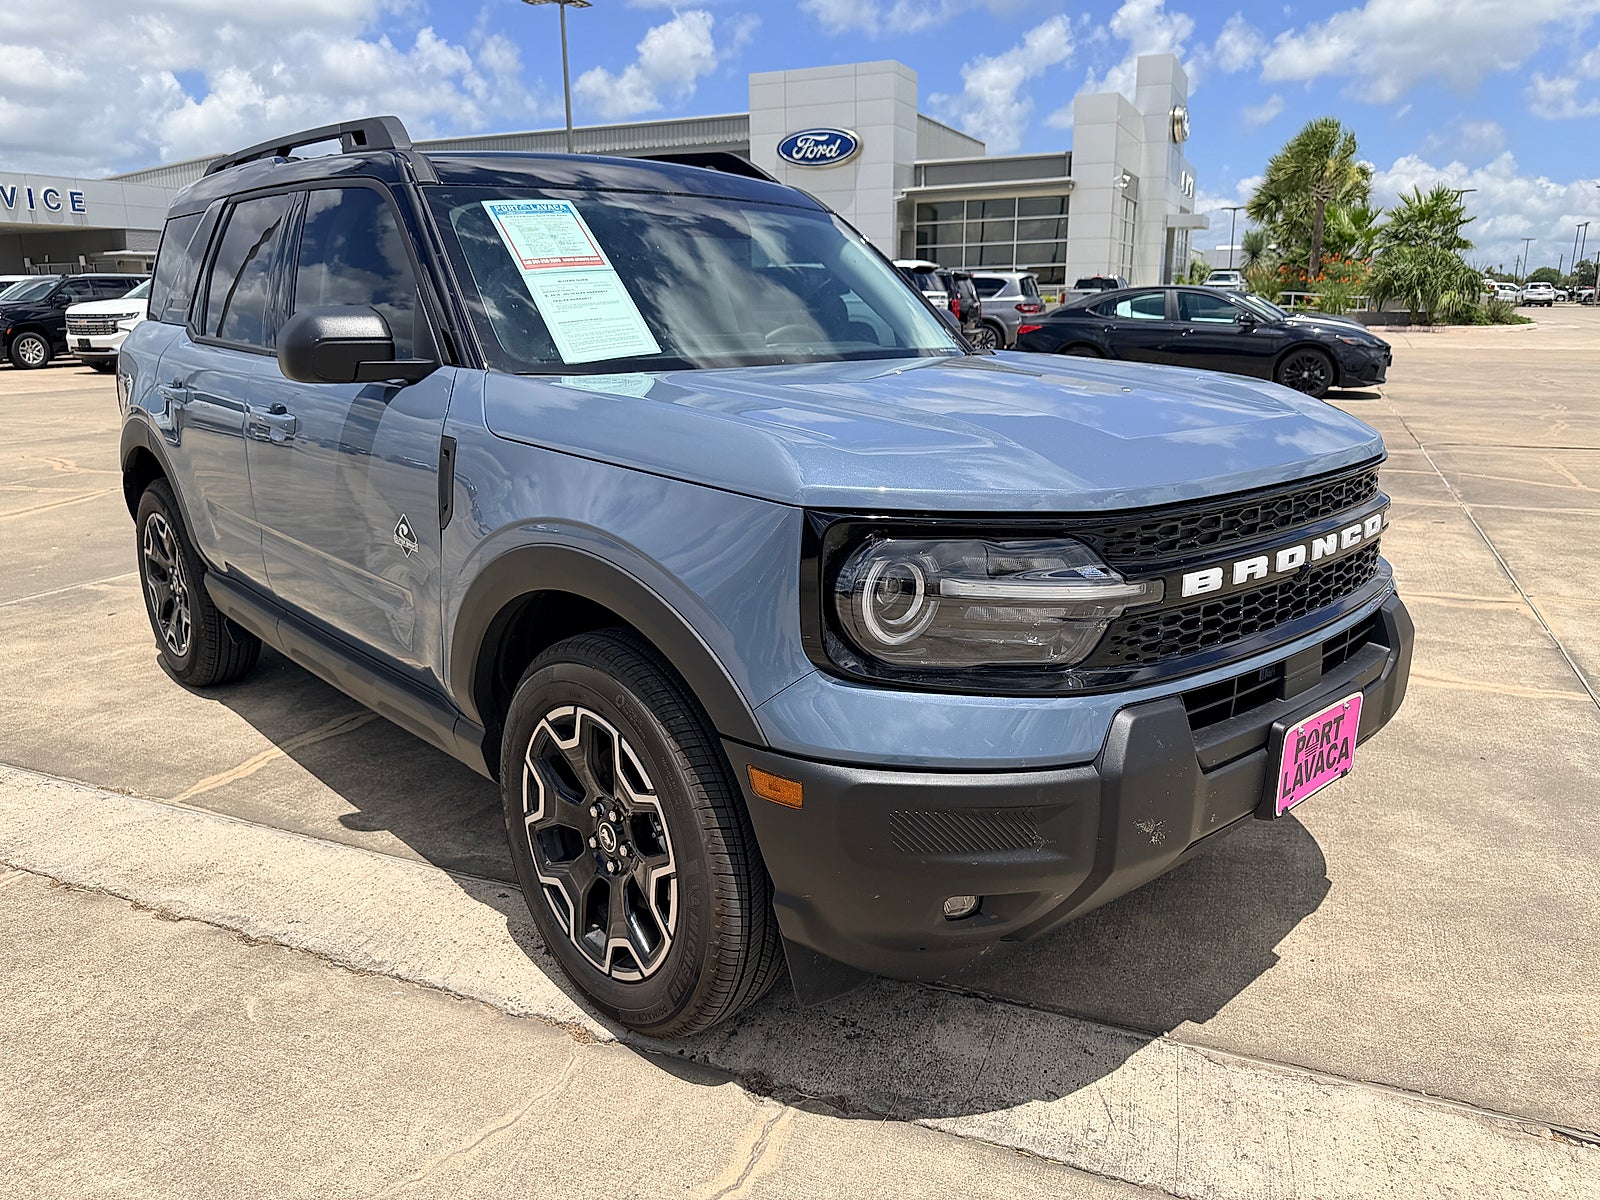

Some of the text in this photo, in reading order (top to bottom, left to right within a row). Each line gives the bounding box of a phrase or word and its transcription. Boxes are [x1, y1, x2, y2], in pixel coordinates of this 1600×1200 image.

[792, 134, 842, 160] Ford
[0, 184, 87, 214] VICE
[494, 204, 519, 212] PORT
[530, 203, 567, 211] LAVACA
[1181, 513, 1382, 598] BRONCO
[1294, 713, 1345, 765] PORT
[1281, 736, 1350, 800] LAVACA
[671, 911, 700, 1003] MICHELIN
[637, 1004, 669, 1023] PRIMACY
